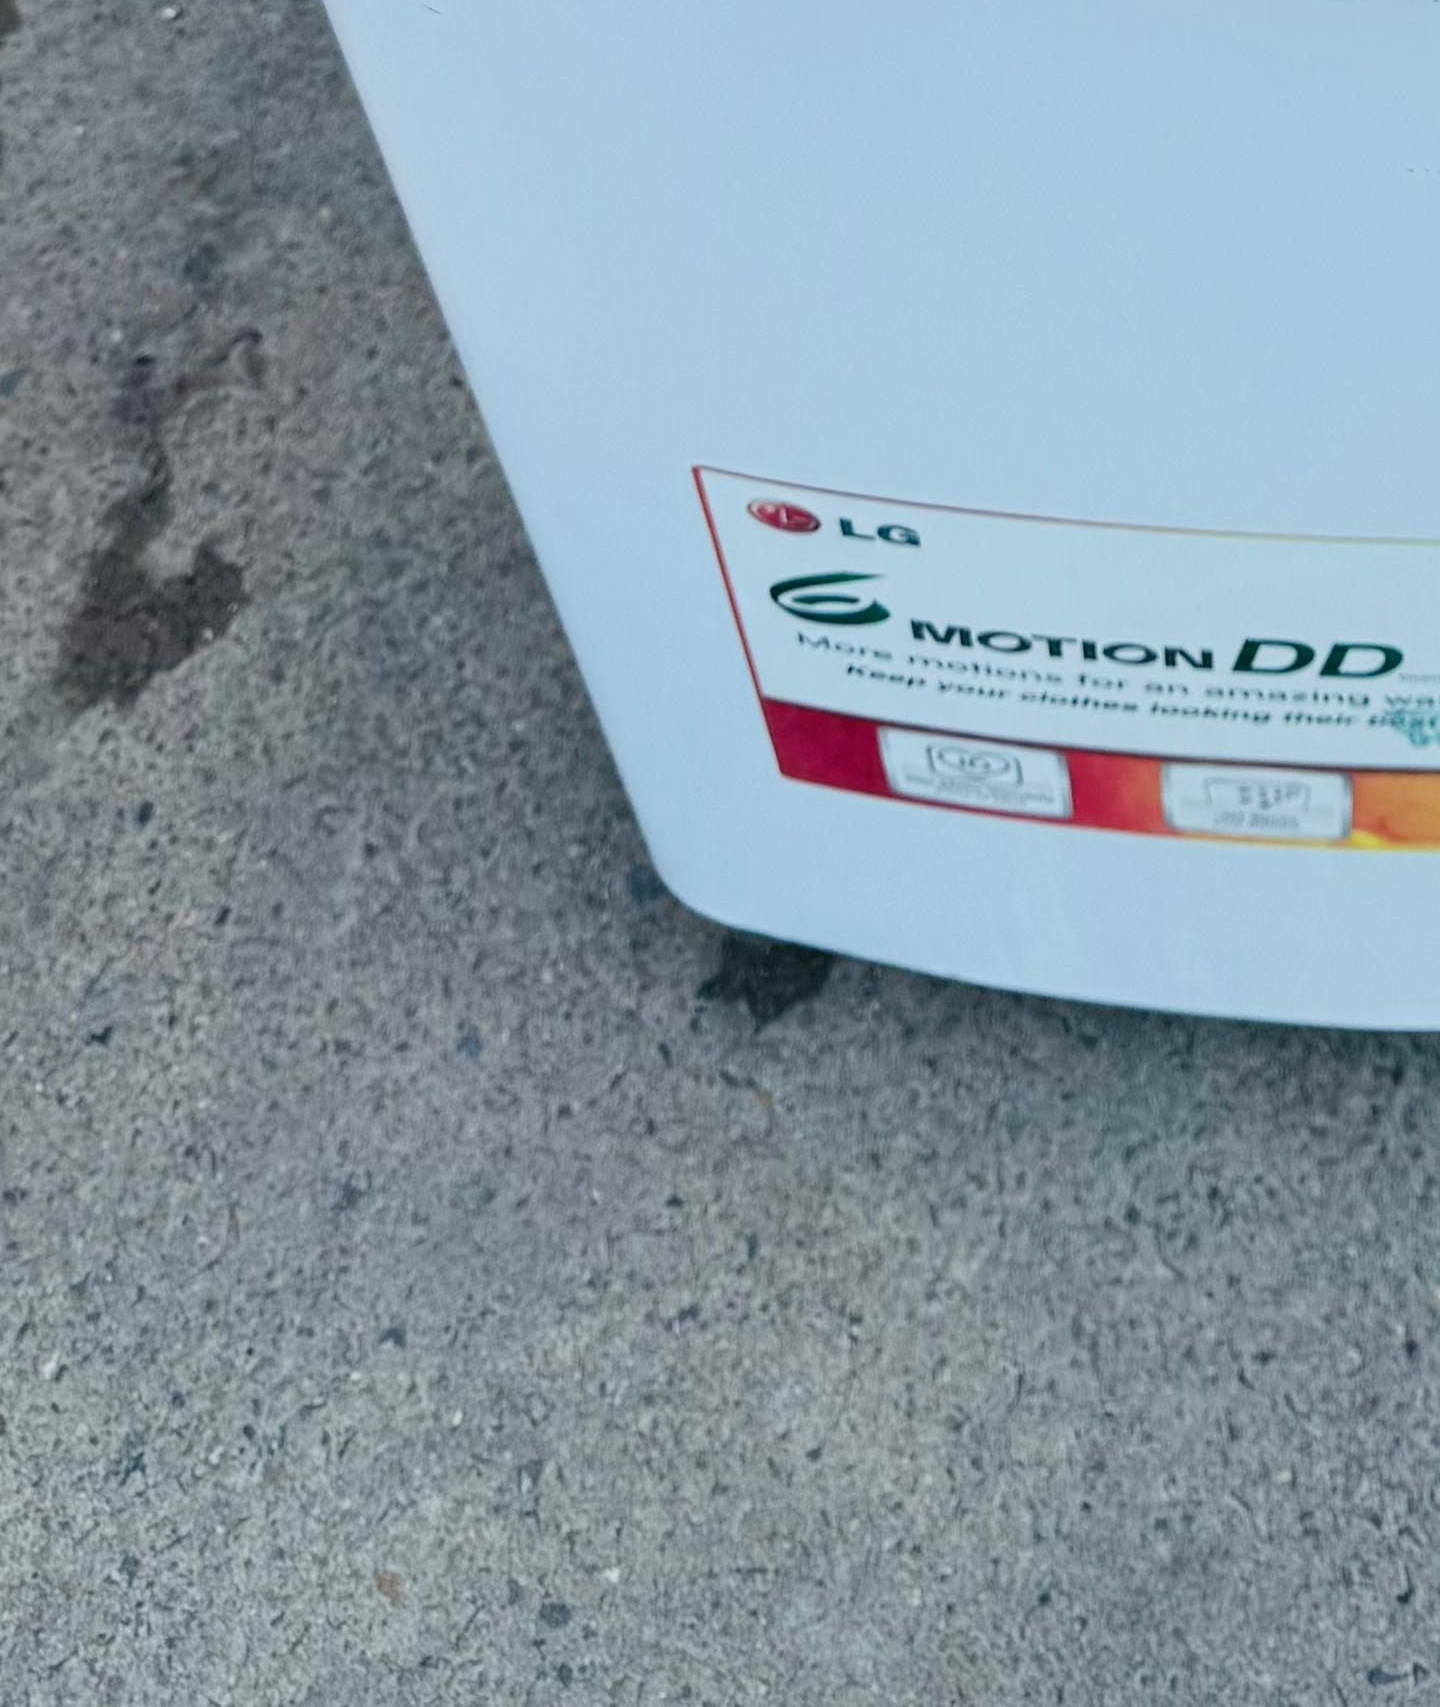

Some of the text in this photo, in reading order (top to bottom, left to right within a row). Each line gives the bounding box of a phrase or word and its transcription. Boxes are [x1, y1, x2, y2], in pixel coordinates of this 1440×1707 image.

[838, 515, 922, 548] LG
[797, 631, 893, 661] More
[907, 654, 1062, 684] motions
[1077, 671, 1130, 689] for
[1144, 680, 1190, 696] an
[1203, 684, 1370, 708] amazing
[909, 618, 1214, 670] MOTION
[1231, 636, 1405, 678] DD
[847, 663, 927, 689] Keep
[938, 679, 1013, 699] your
[1020, 690, 1139, 713] clothes
[1149, 701, 1272, 724] looking
[1283, 711, 1361, 727] their
